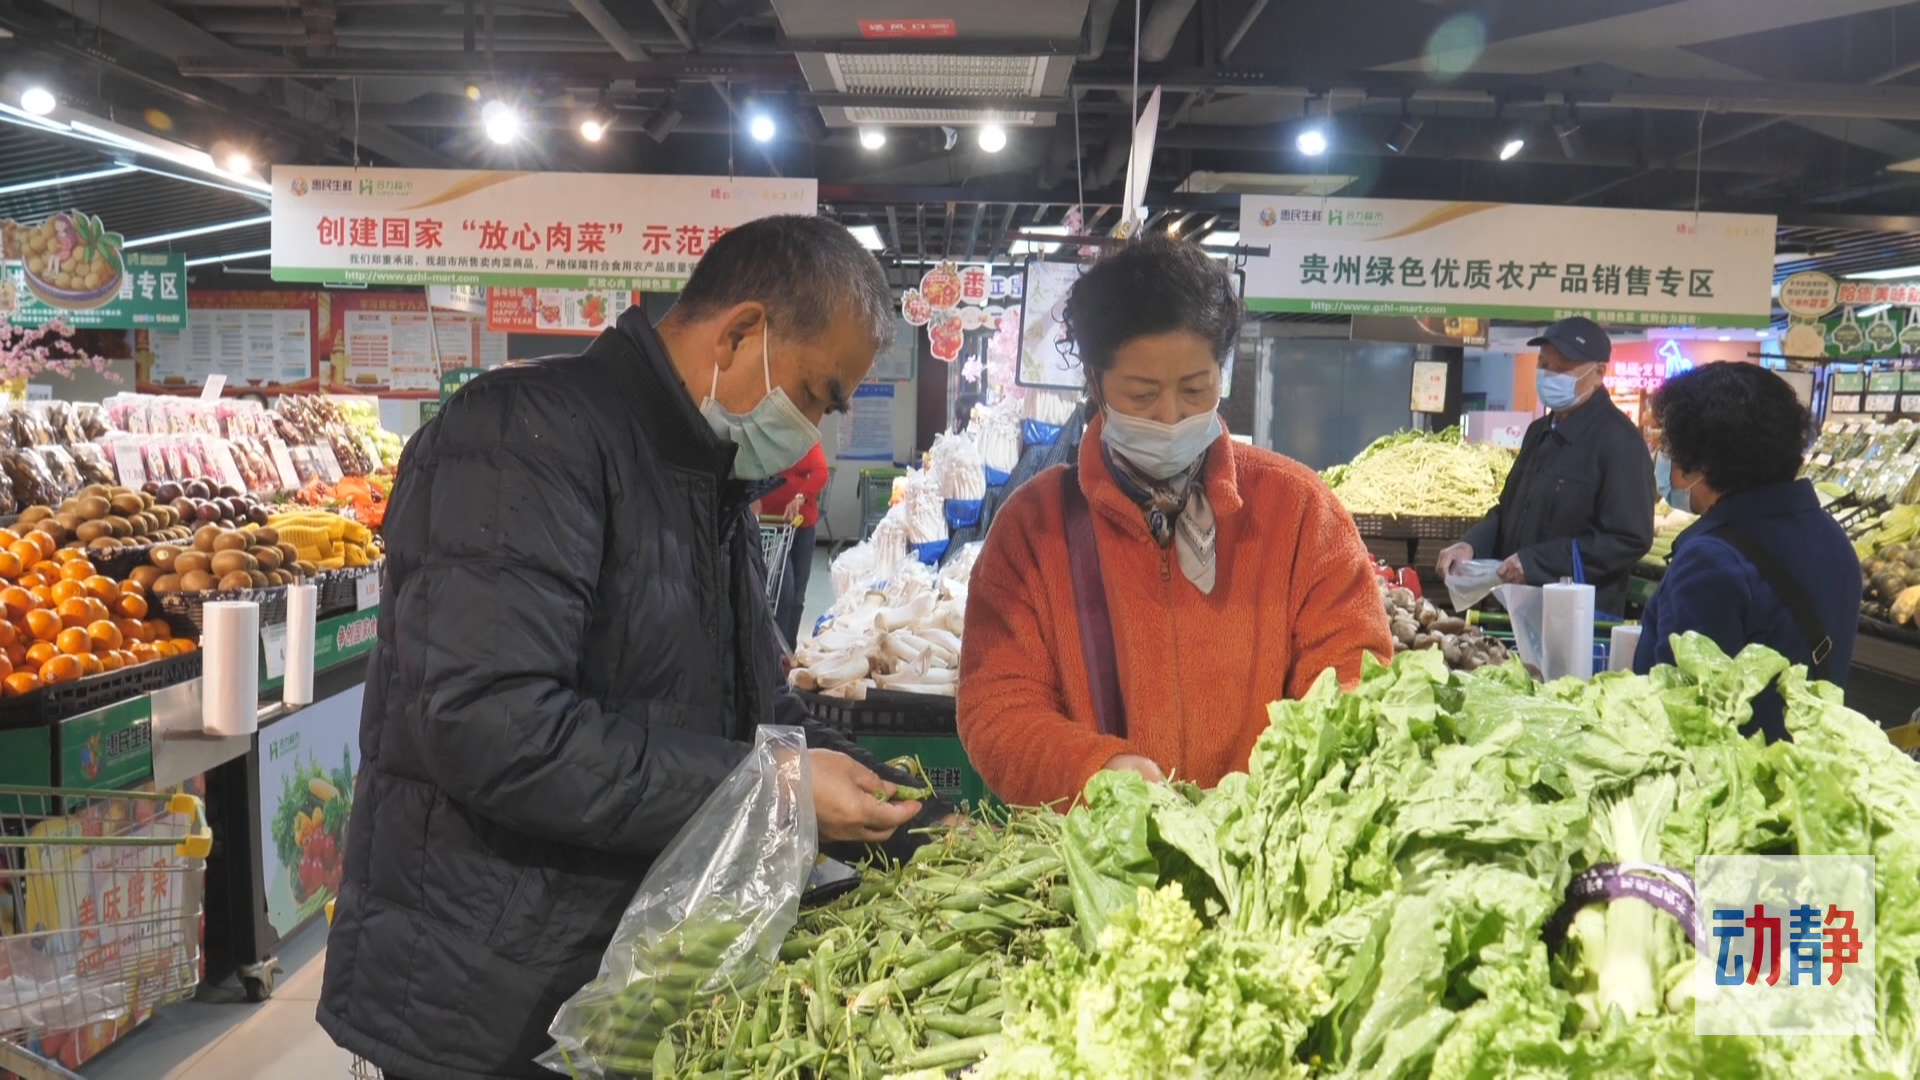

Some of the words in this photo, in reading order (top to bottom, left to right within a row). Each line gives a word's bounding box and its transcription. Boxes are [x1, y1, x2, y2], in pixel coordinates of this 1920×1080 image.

[312, 179, 352, 191] 惠民生鲜
[1281, 209, 1322, 221] 惠民生鲜
[1300, 253, 1714, 298] 贵州绿色优质农产品销售专区
[963, 272, 985, 298] 番
[492, 309, 519, 317] HAPPY
[492, 317, 511, 325] NEW
[512, 317, 533, 325] YEAR
